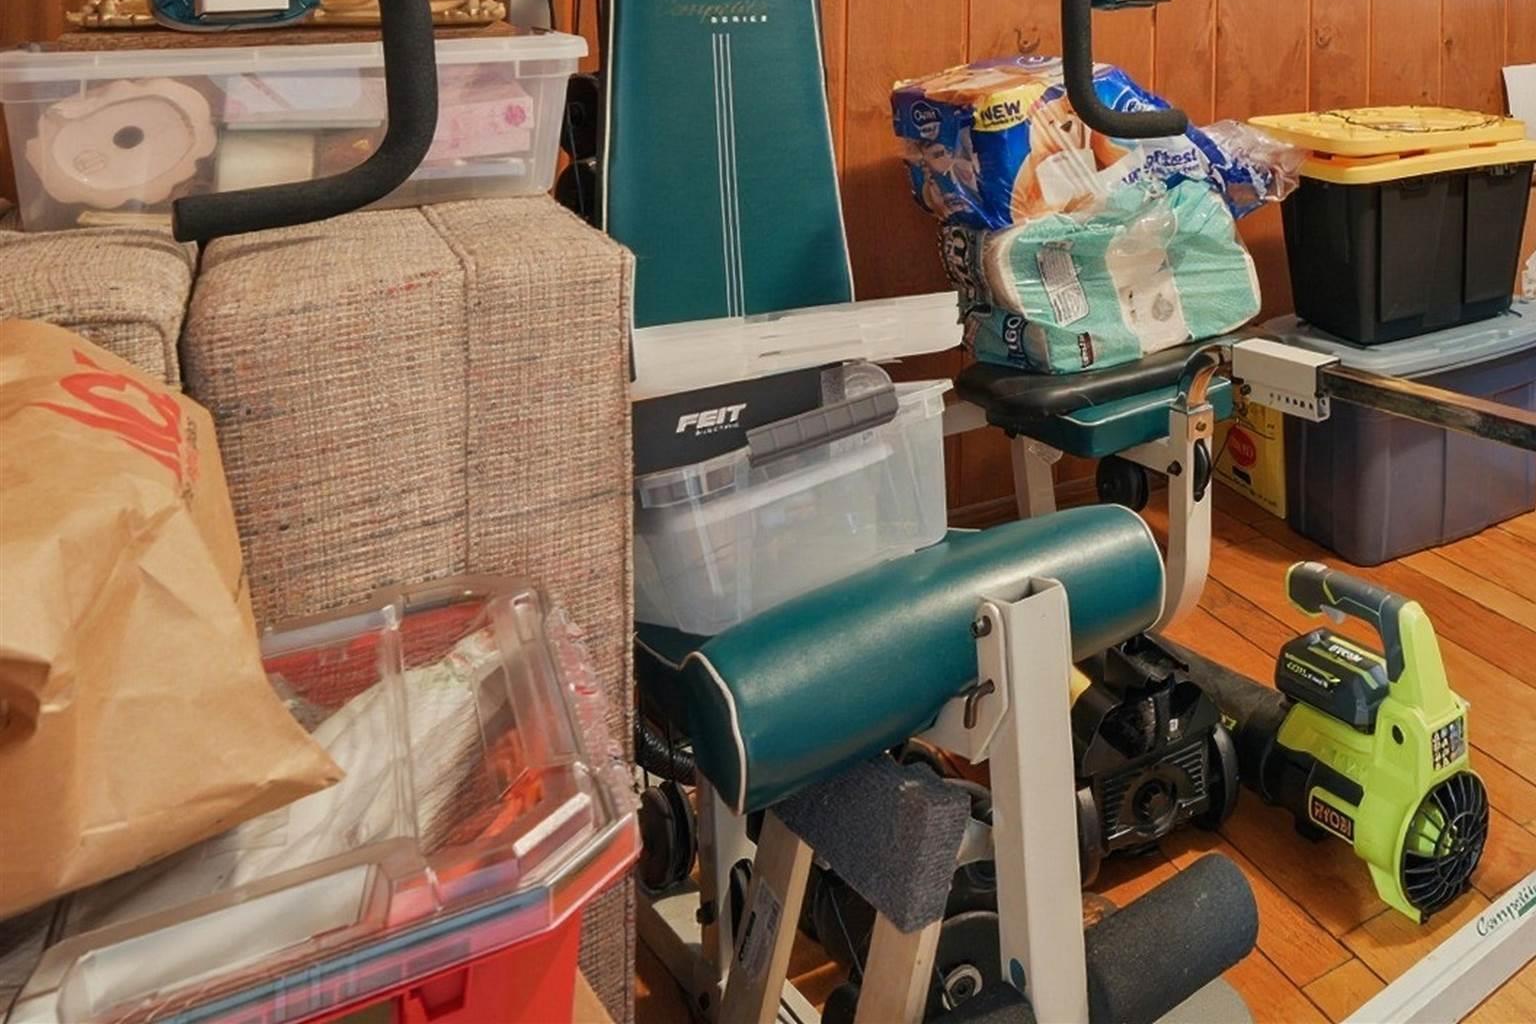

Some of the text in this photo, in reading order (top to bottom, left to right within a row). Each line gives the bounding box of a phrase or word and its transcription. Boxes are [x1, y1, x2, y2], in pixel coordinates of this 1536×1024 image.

[980, 99, 1021, 121] NEW
[676, 403, 747, 433] FEIT
[1314, 800, 1352, 837] RYOBI
